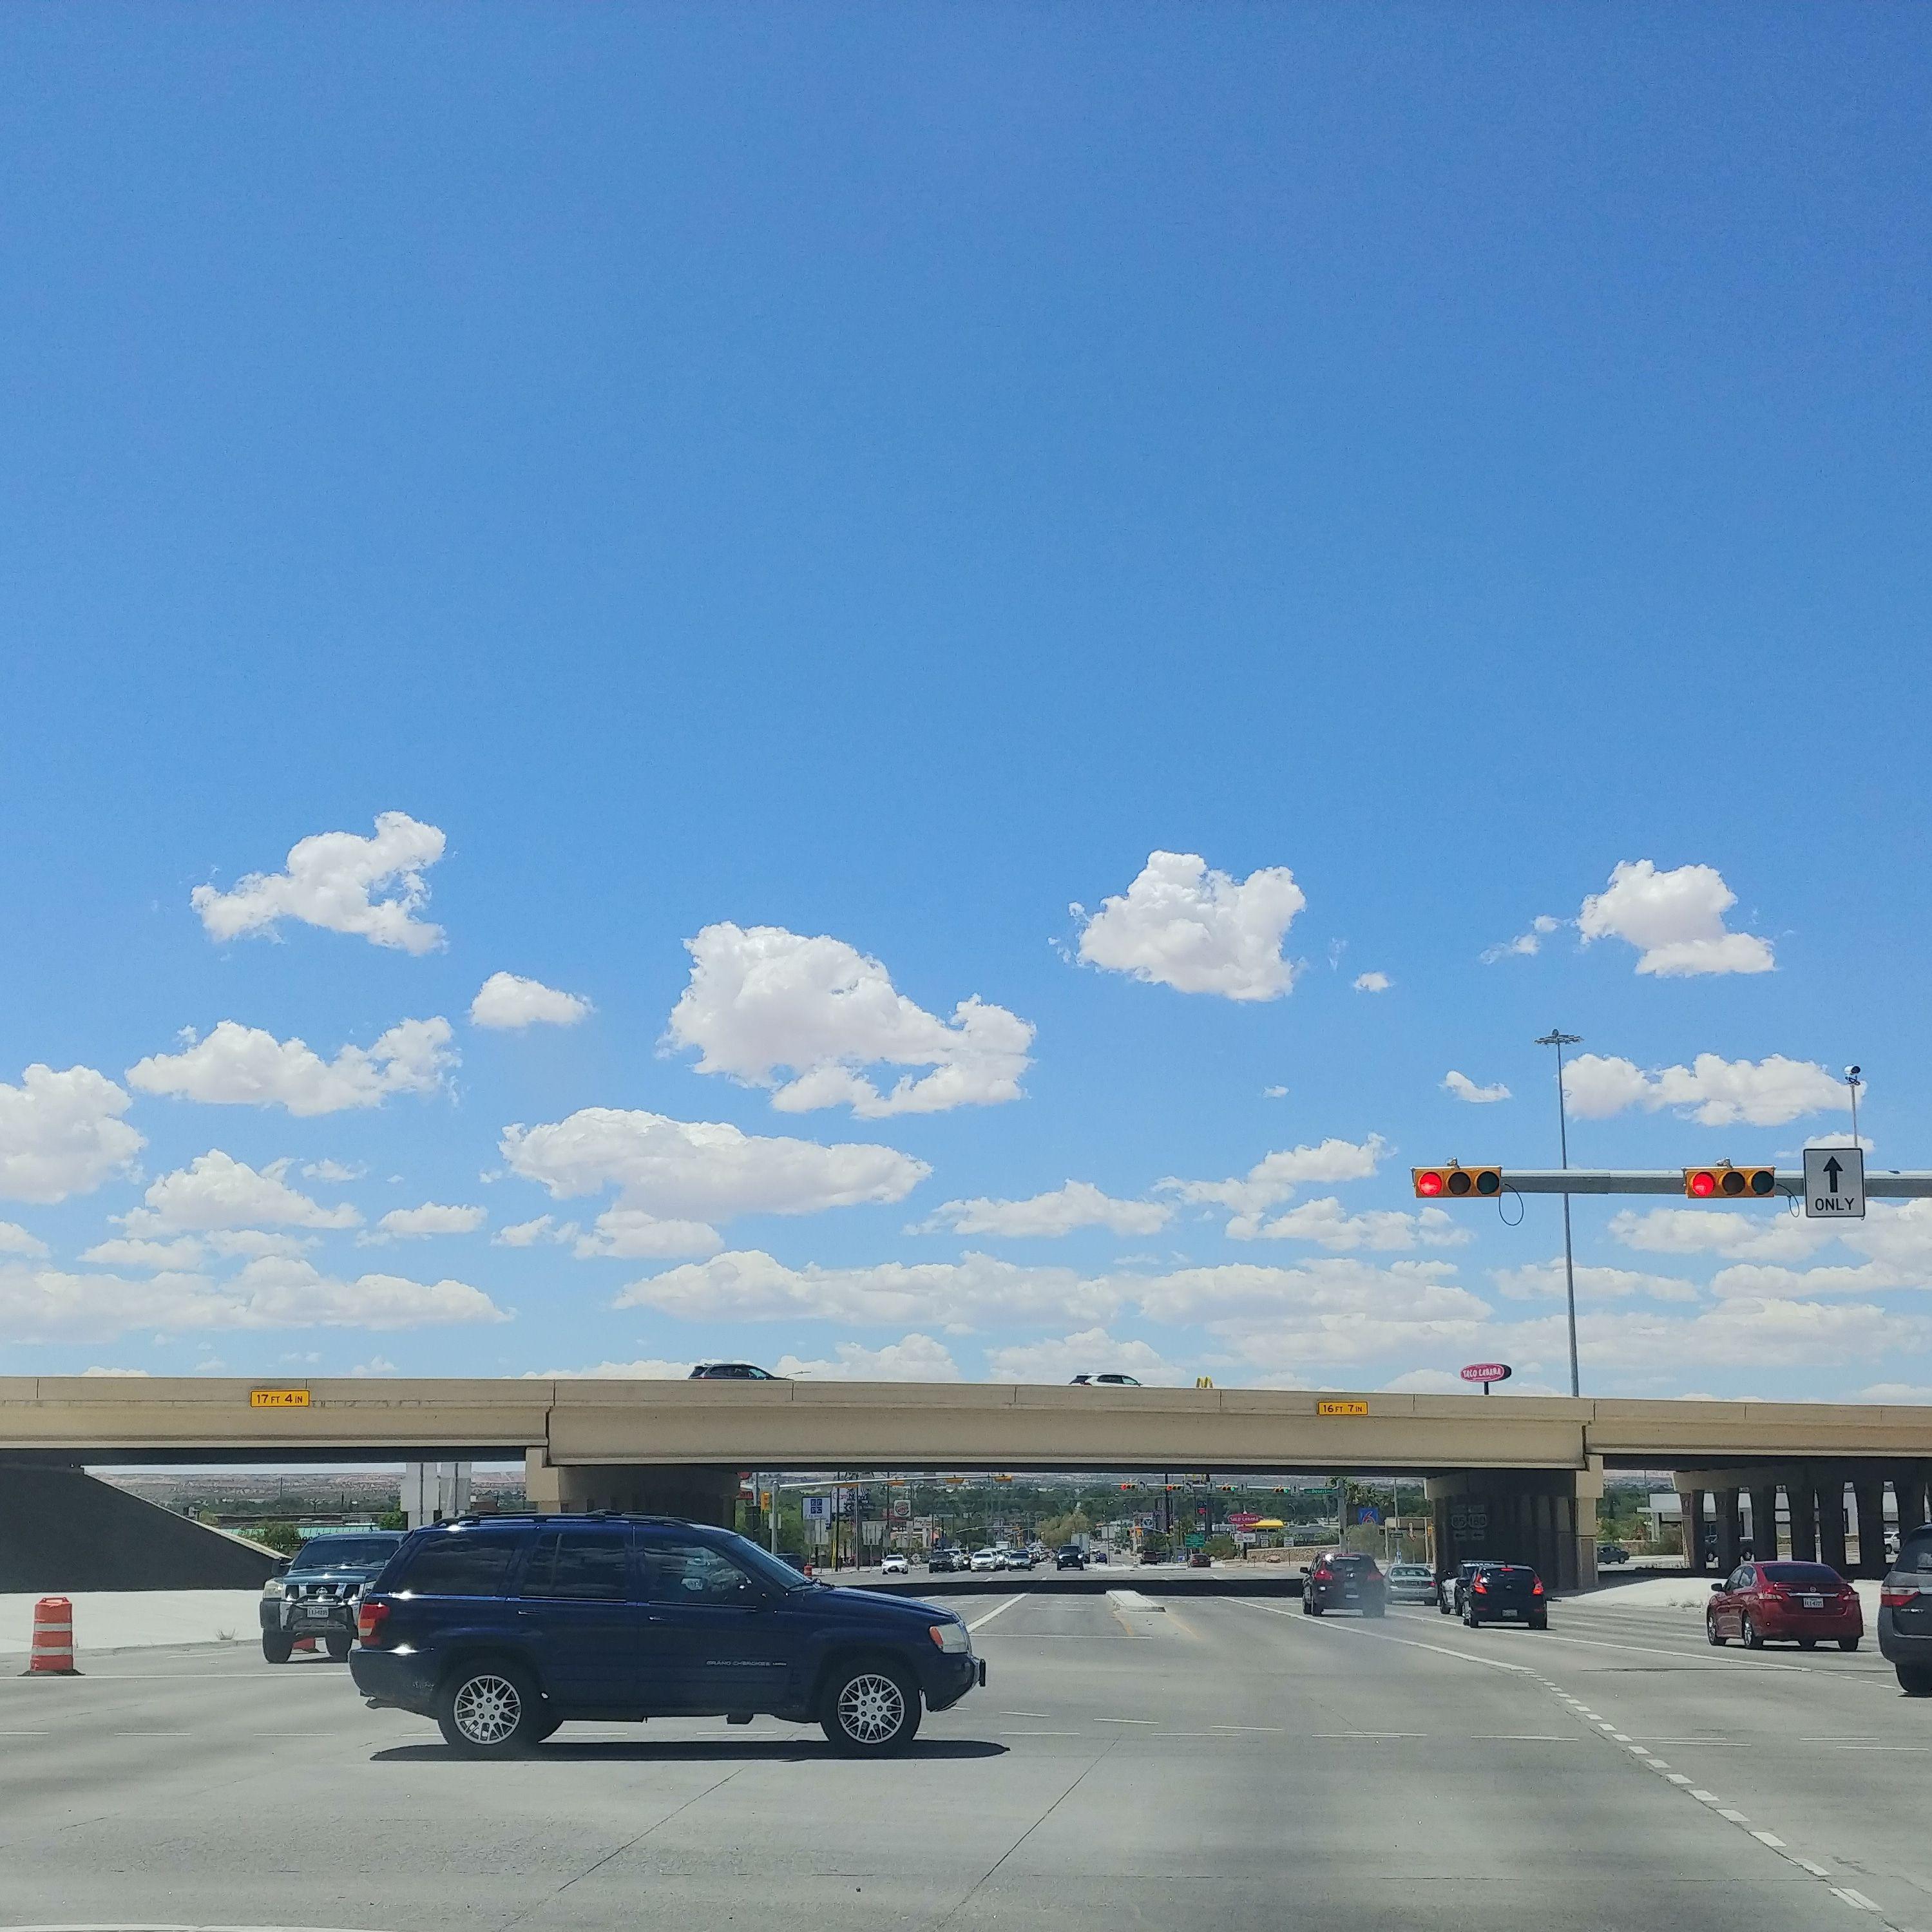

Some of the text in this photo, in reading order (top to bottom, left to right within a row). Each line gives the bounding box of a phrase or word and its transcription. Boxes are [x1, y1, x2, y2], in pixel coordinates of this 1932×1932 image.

[1815, 1198, 1855, 1210] ONLY
[1462, 1367, 1501, 1378] TACO CABANA
[257, 1393, 269, 1404] 17
[285, 1393, 292, 1403] 4
[1323, 1404, 1334, 1413] 16
[1362, 1511, 1375, 1525] 6
